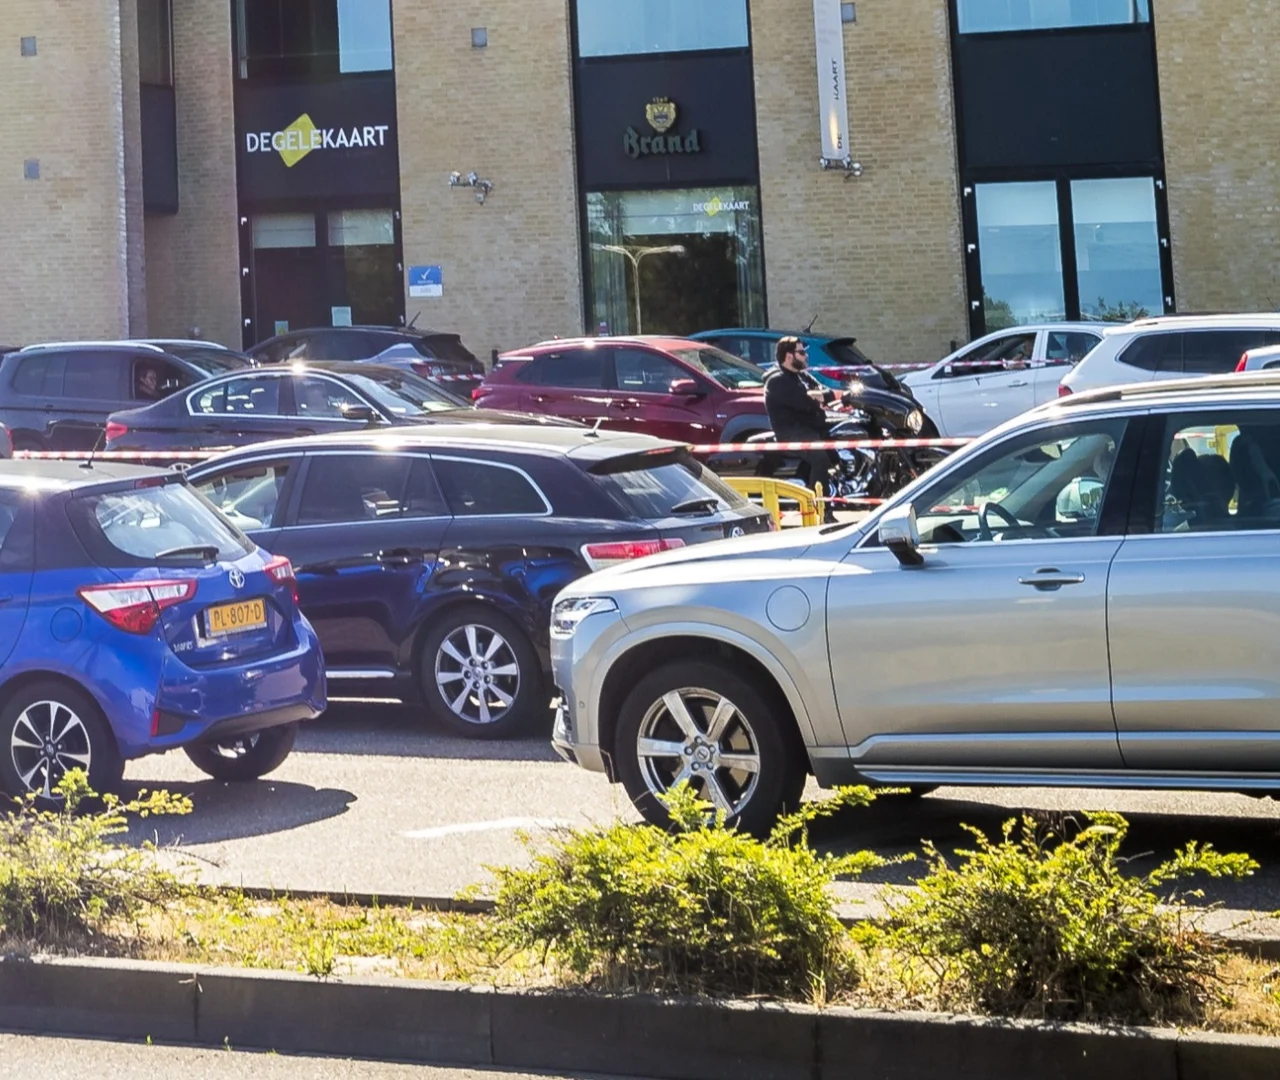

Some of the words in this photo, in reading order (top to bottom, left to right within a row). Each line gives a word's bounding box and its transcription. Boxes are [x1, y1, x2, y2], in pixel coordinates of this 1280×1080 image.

[246, 125, 389, 152] DEGELEKAART
[623, 126, 700, 159] Brand
[692, 200, 750, 213] DEGELEKAART
[213, 603, 262, 627] PL-807-D
